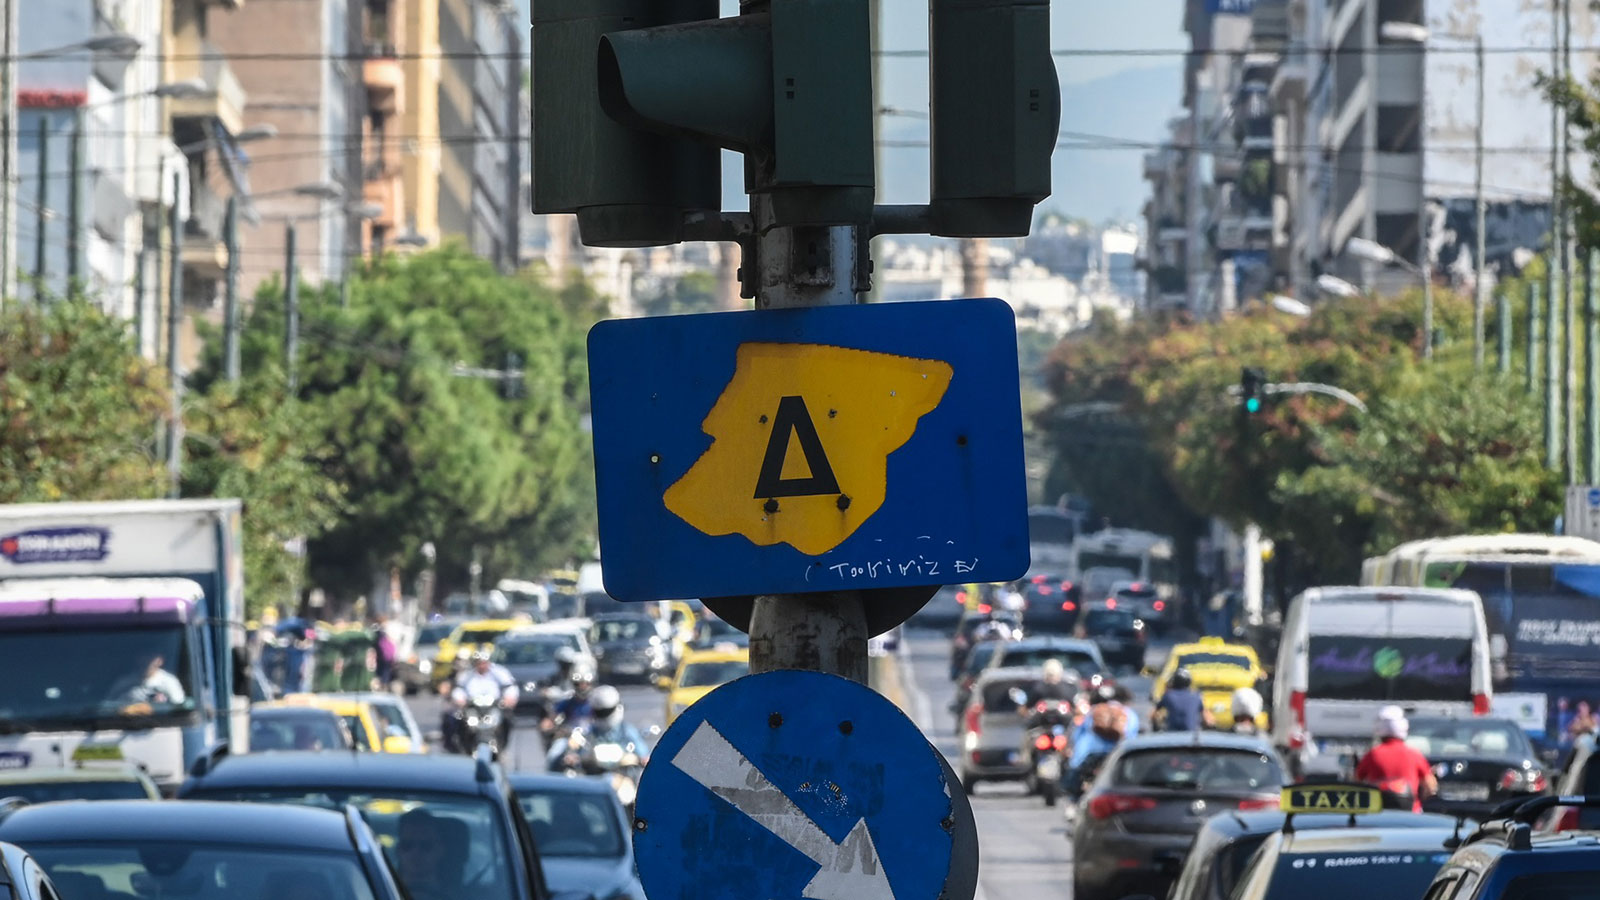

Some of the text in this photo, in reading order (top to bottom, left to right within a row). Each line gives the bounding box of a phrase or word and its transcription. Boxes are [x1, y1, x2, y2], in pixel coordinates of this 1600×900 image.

[1301, 791, 1361, 809] TAXI
[1324, 857, 1369, 868] RADIO
[1370, 855, 1401, 865] TAXI
